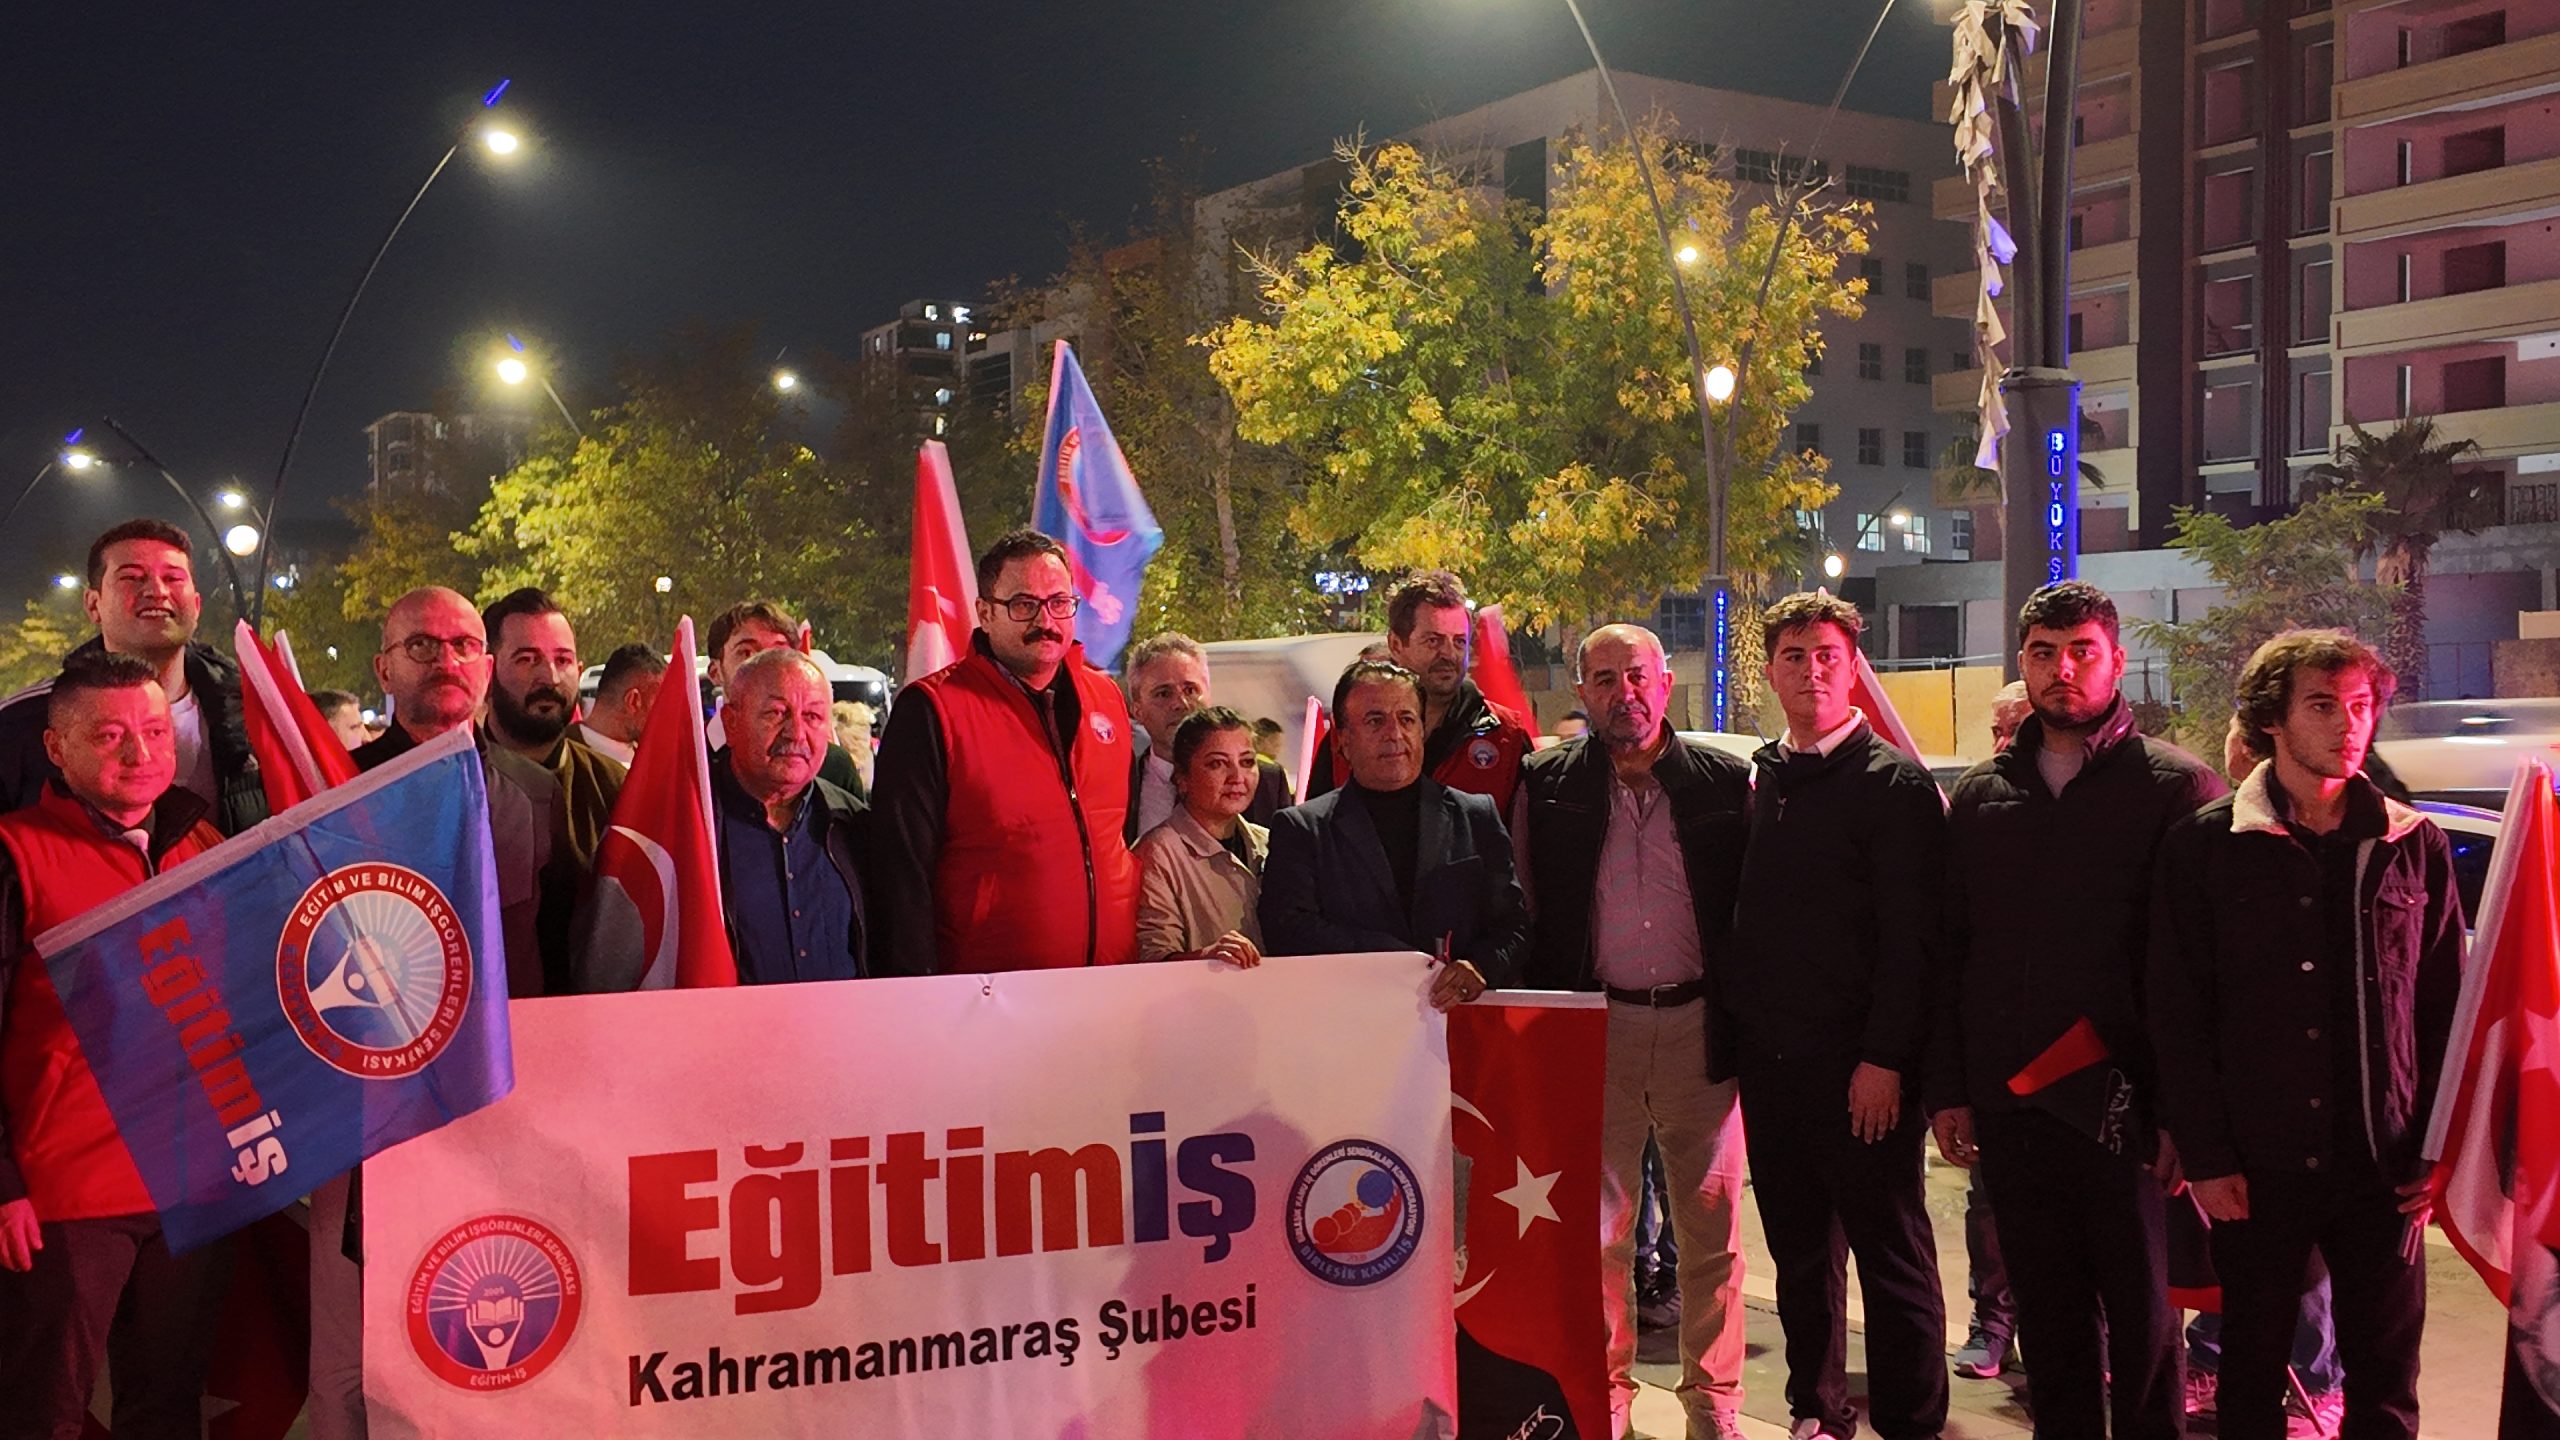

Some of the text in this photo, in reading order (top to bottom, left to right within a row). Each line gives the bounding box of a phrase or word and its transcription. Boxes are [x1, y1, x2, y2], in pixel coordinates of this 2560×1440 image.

[2050, 431, 2065, 585] BÜYÜKŞ
[300, 881, 346, 927] EĞİTİM
[349, 873, 372, 888] VE
[378, 871, 427, 901] BİLİM
[426, 894, 464, 1028] İŞGÖRENLERİ
[412, 1219, 577, 1314] EĞİTİM VE BİLİM İŞGÖRENLERİ SENDİKASI
[1302, 1239, 1413, 1279] BİRLEŞİK KAMU-İŞ
[629, 1284, 1257, 1407] Kahramanmaraş Şubesi
